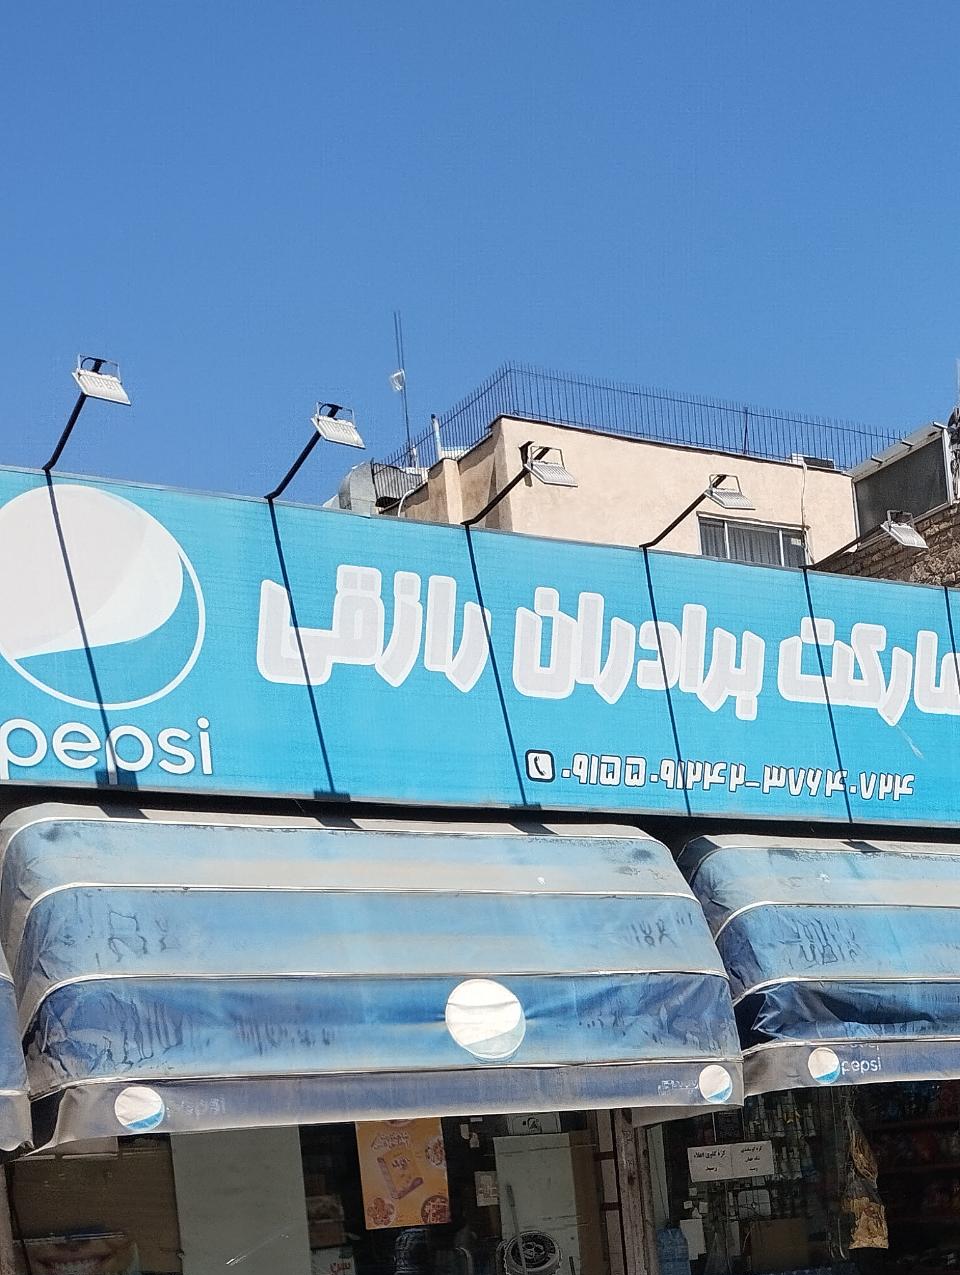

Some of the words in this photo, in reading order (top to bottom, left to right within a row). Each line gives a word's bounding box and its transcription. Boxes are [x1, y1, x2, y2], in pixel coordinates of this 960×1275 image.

[256, 565, 491, 694] رازقی
[512, 586, 765, 722] برادران
[0, 717, 214, 785] pepsi
[841, 1056, 882, 1075] pepsi
